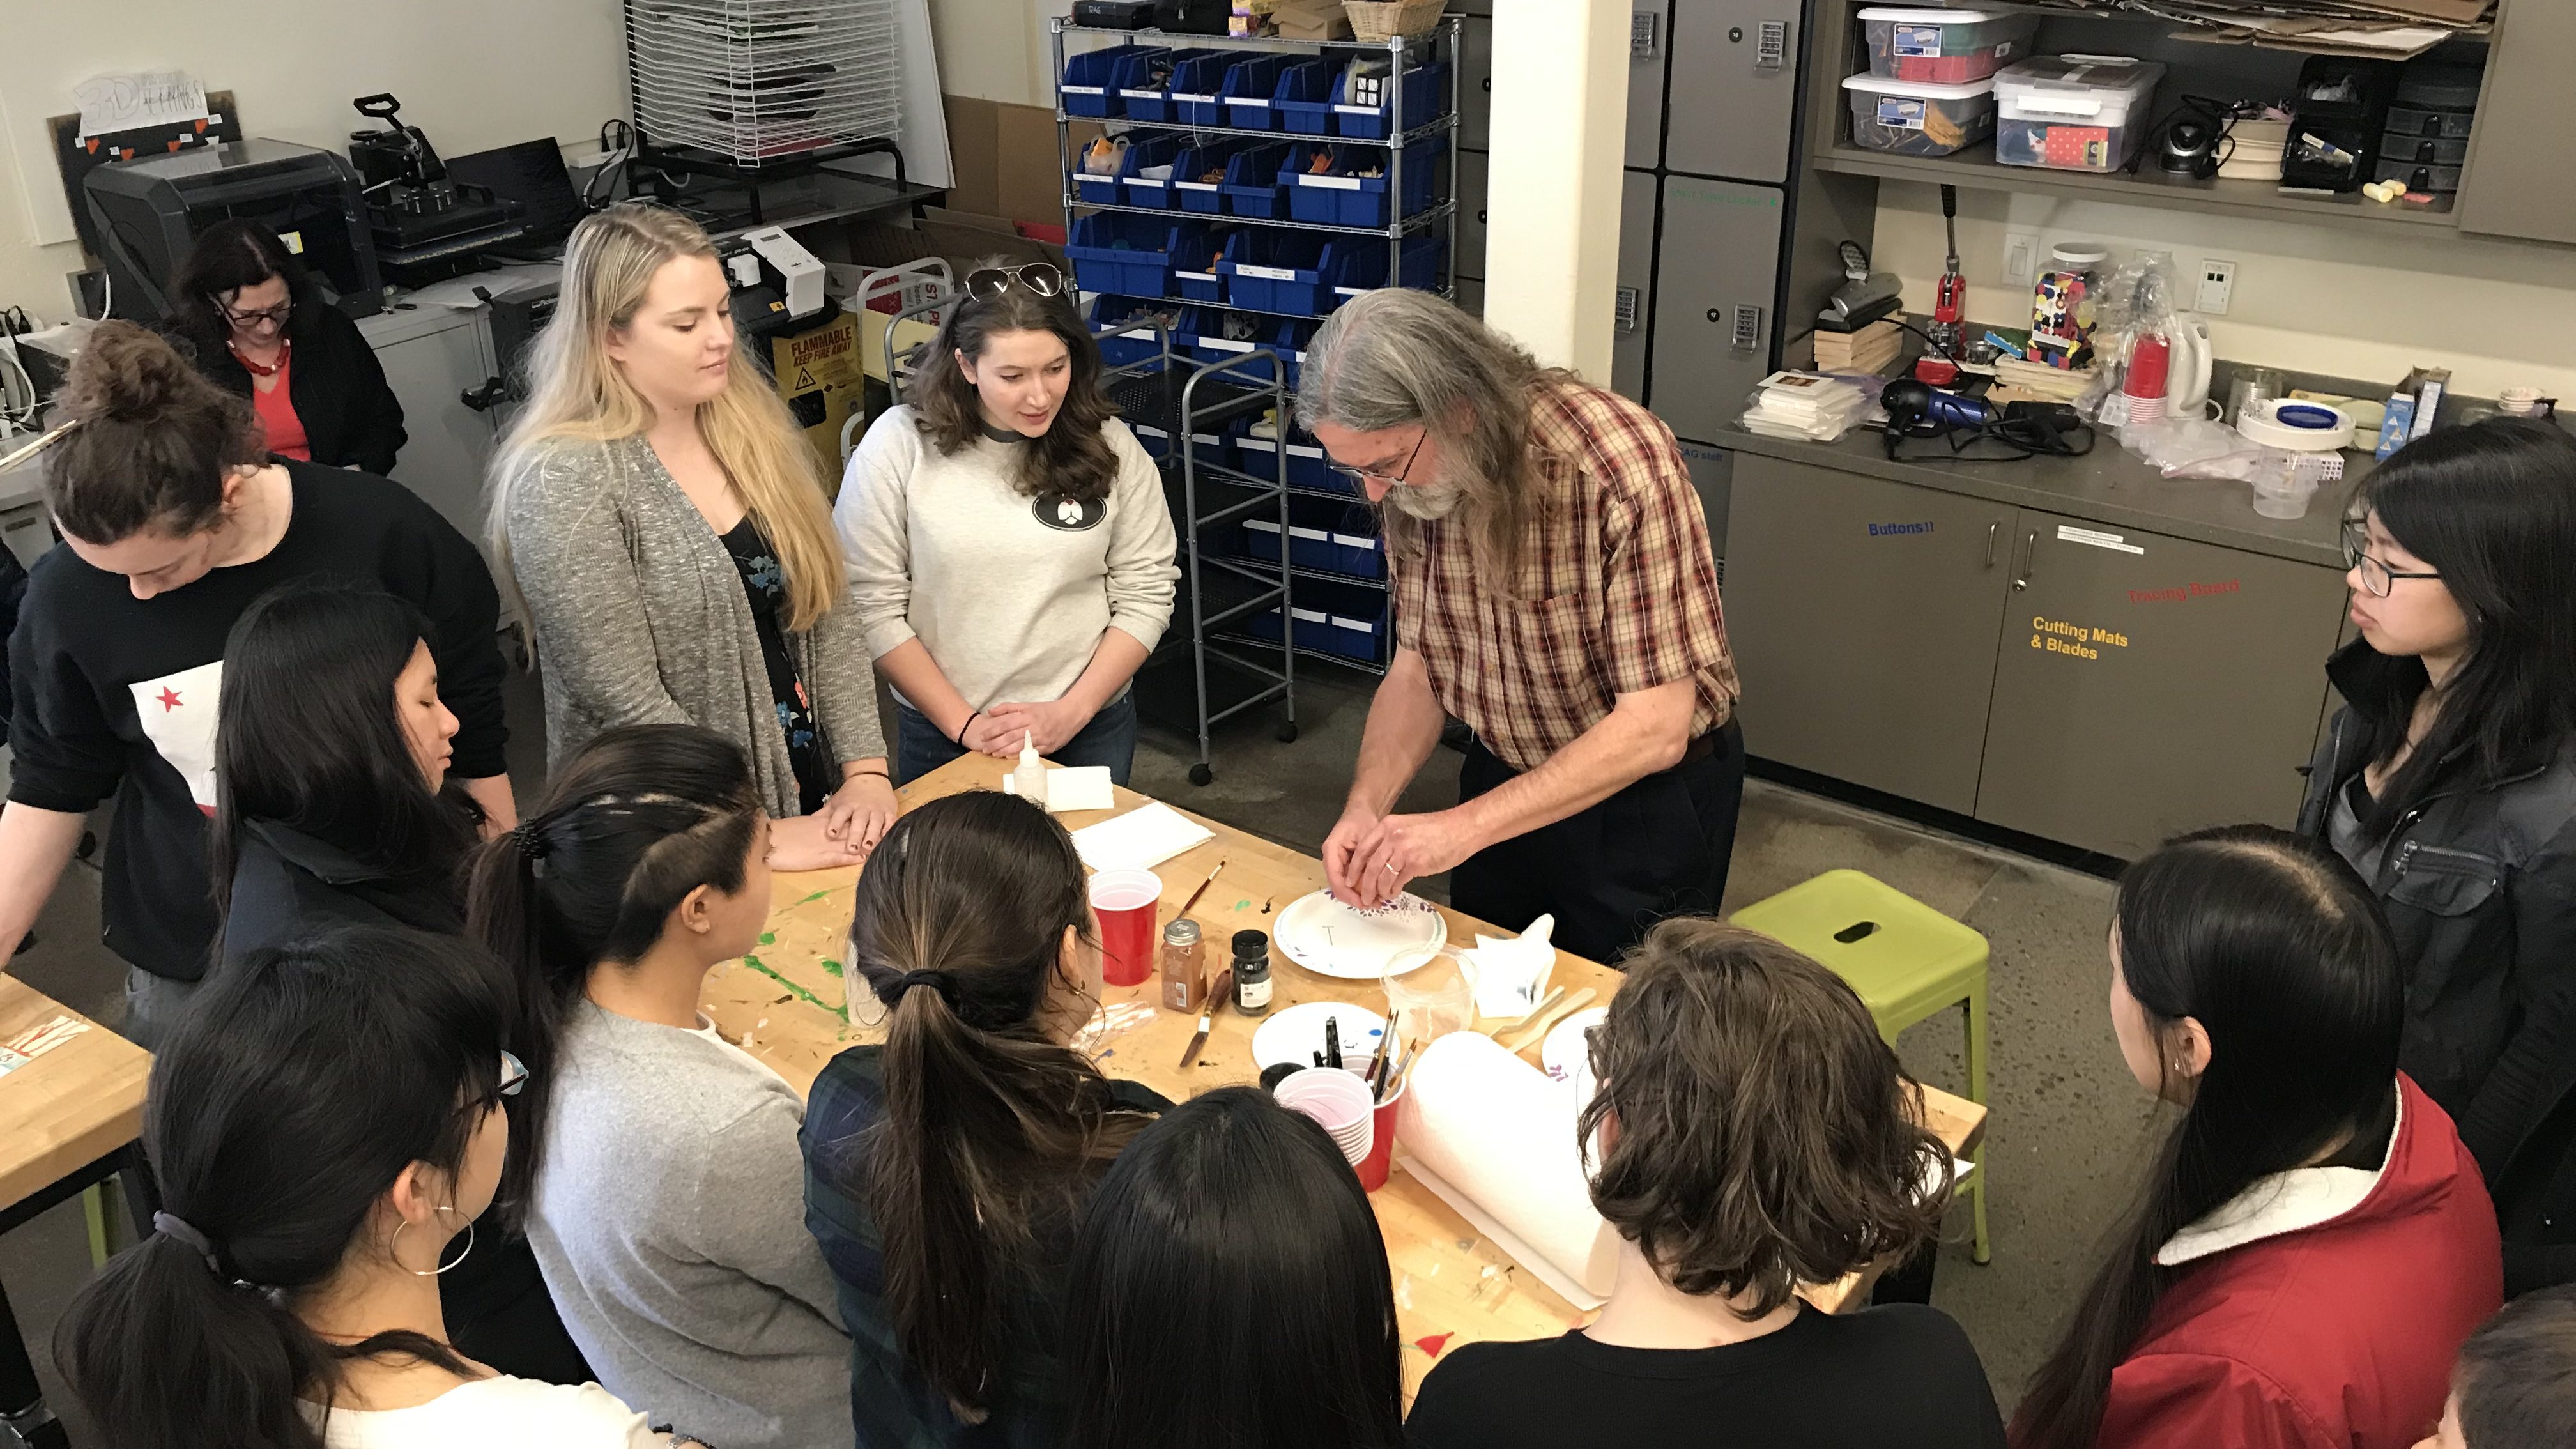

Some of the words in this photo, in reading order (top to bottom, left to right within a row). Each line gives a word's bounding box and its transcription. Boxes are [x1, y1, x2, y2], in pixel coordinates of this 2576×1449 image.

[73, 75, 140, 128] 3D
[791, 326, 852, 357] FLAMMABLE
[793, 353, 813, 367] KEEP
[814, 347, 831, 362] FIRE
[831, 340, 852, 356] AWAY
[1868, 521, 1935, 537] Buttons!!
[2128, 587, 2186, 603] Tracing
[2189, 578, 2239, 597] Board
[2033, 616, 2088, 642] Cutting
[2092, 627, 2128, 647] Mats
[2030, 634, 2042, 649] &
[2046, 637, 2098, 660] Blades
